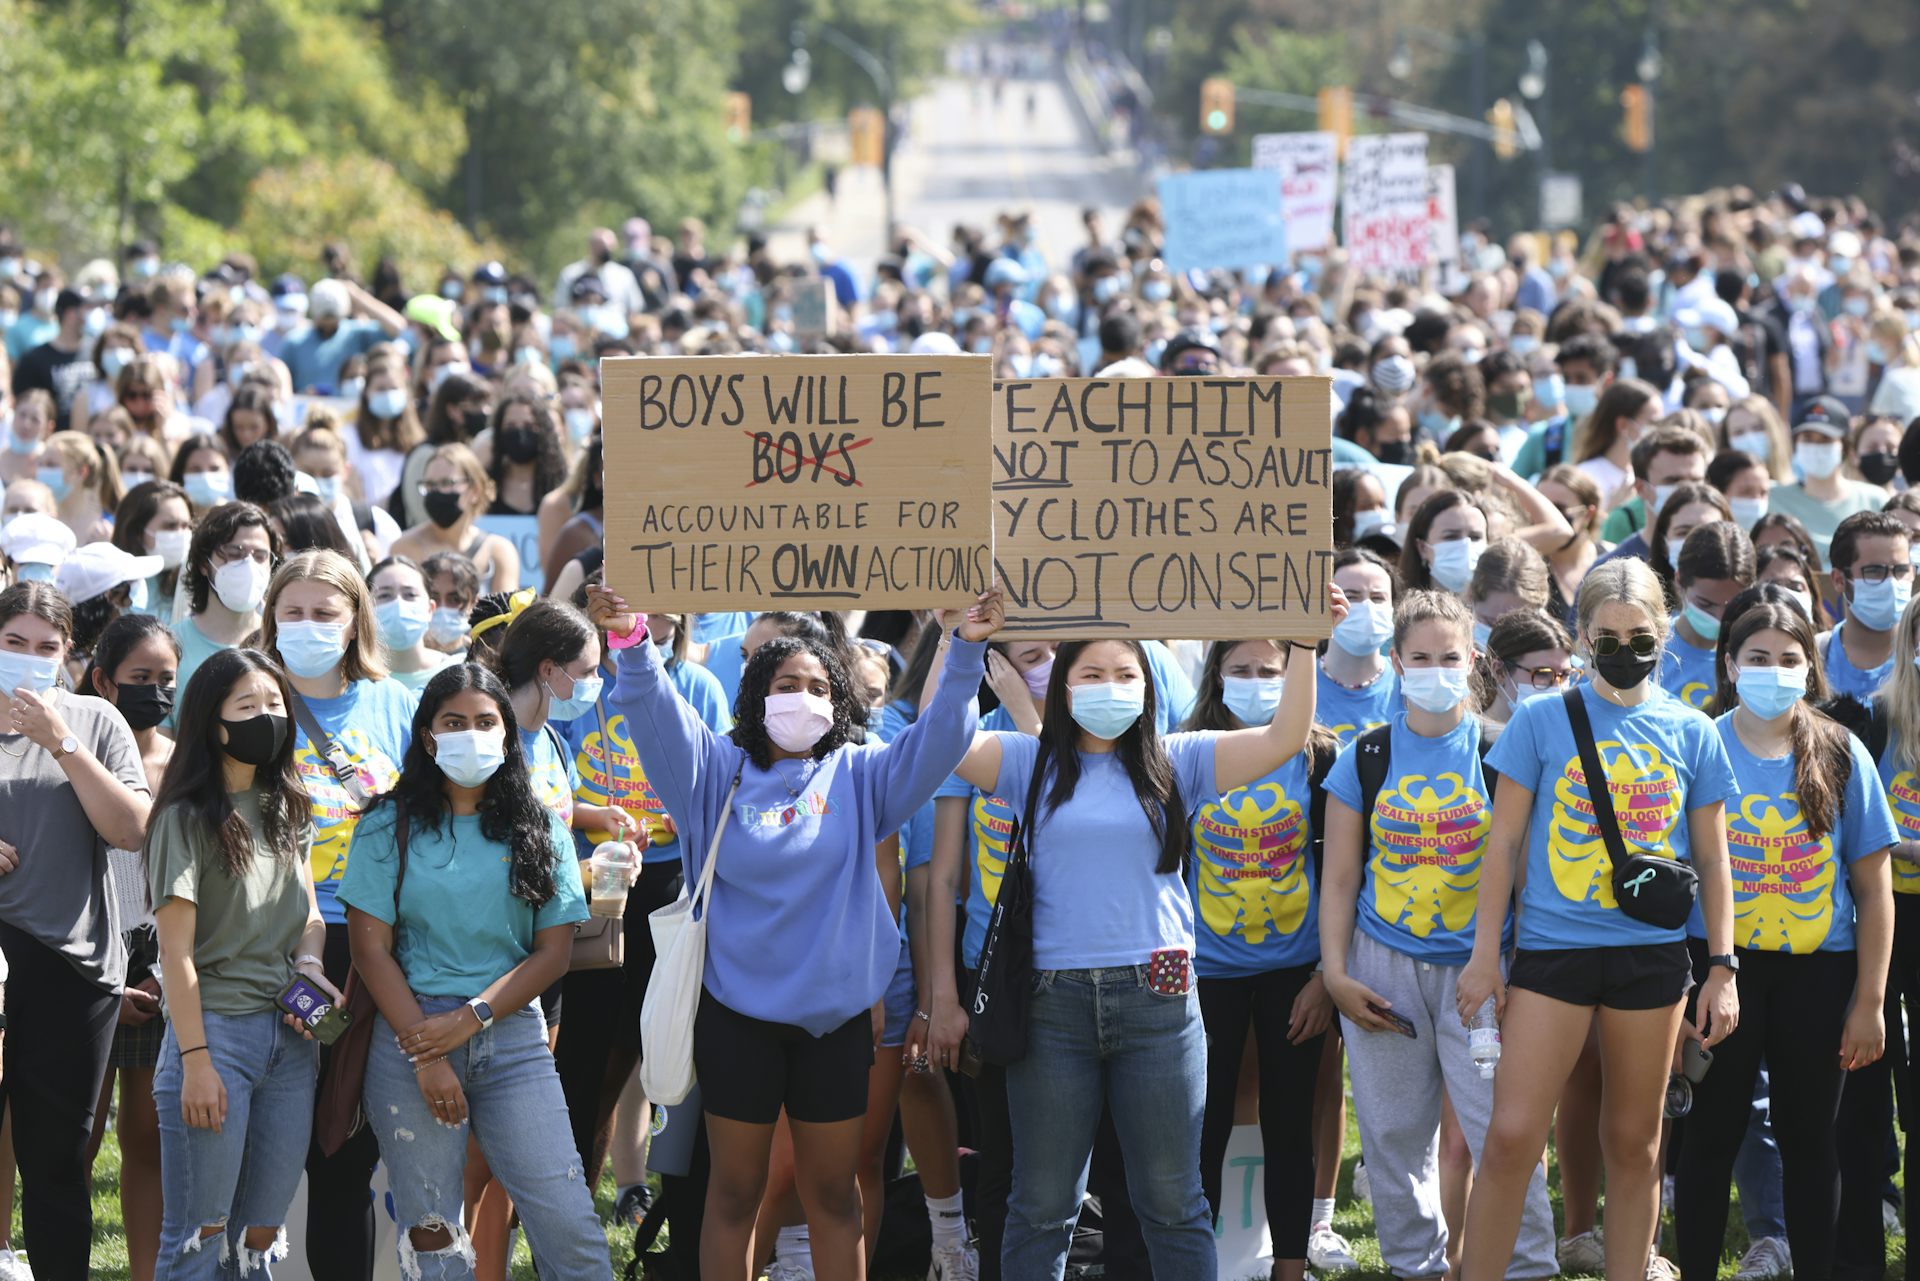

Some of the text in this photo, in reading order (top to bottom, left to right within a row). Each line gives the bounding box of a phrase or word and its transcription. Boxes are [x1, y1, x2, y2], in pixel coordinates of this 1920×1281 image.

[640, 371, 945, 430] BOYS WILL BE
[993, 381, 1282, 438] EACH HIM
[753, 431, 856, 487] BOYS
[993, 438, 1332, 489] NOT TO ASSAULT
[642, 501, 960, 533] ACCOUNTABLE FOR
[1037, 498, 1219, 541] CLOTHES
[1234, 501, 1308, 536] ARE
[631, 541, 990, 596] THEIR OWN ACTIONS
[993, 551, 1334, 621] NOT CONSENT
[1621, 779, 1677, 795] STUDIES
[1199, 811, 1302, 838] HEALTH STUDIES
[1376, 800, 1483, 823] HEALTH STUDIES
[1210, 842, 1294, 863] KINESIOLOGY
[1384, 831, 1472, 848] KINESIOLOGY
[1222, 867, 1282, 878] NURSING
[1400, 854, 1458, 866] NURSING
[1742, 881, 1802, 893] NURSING
